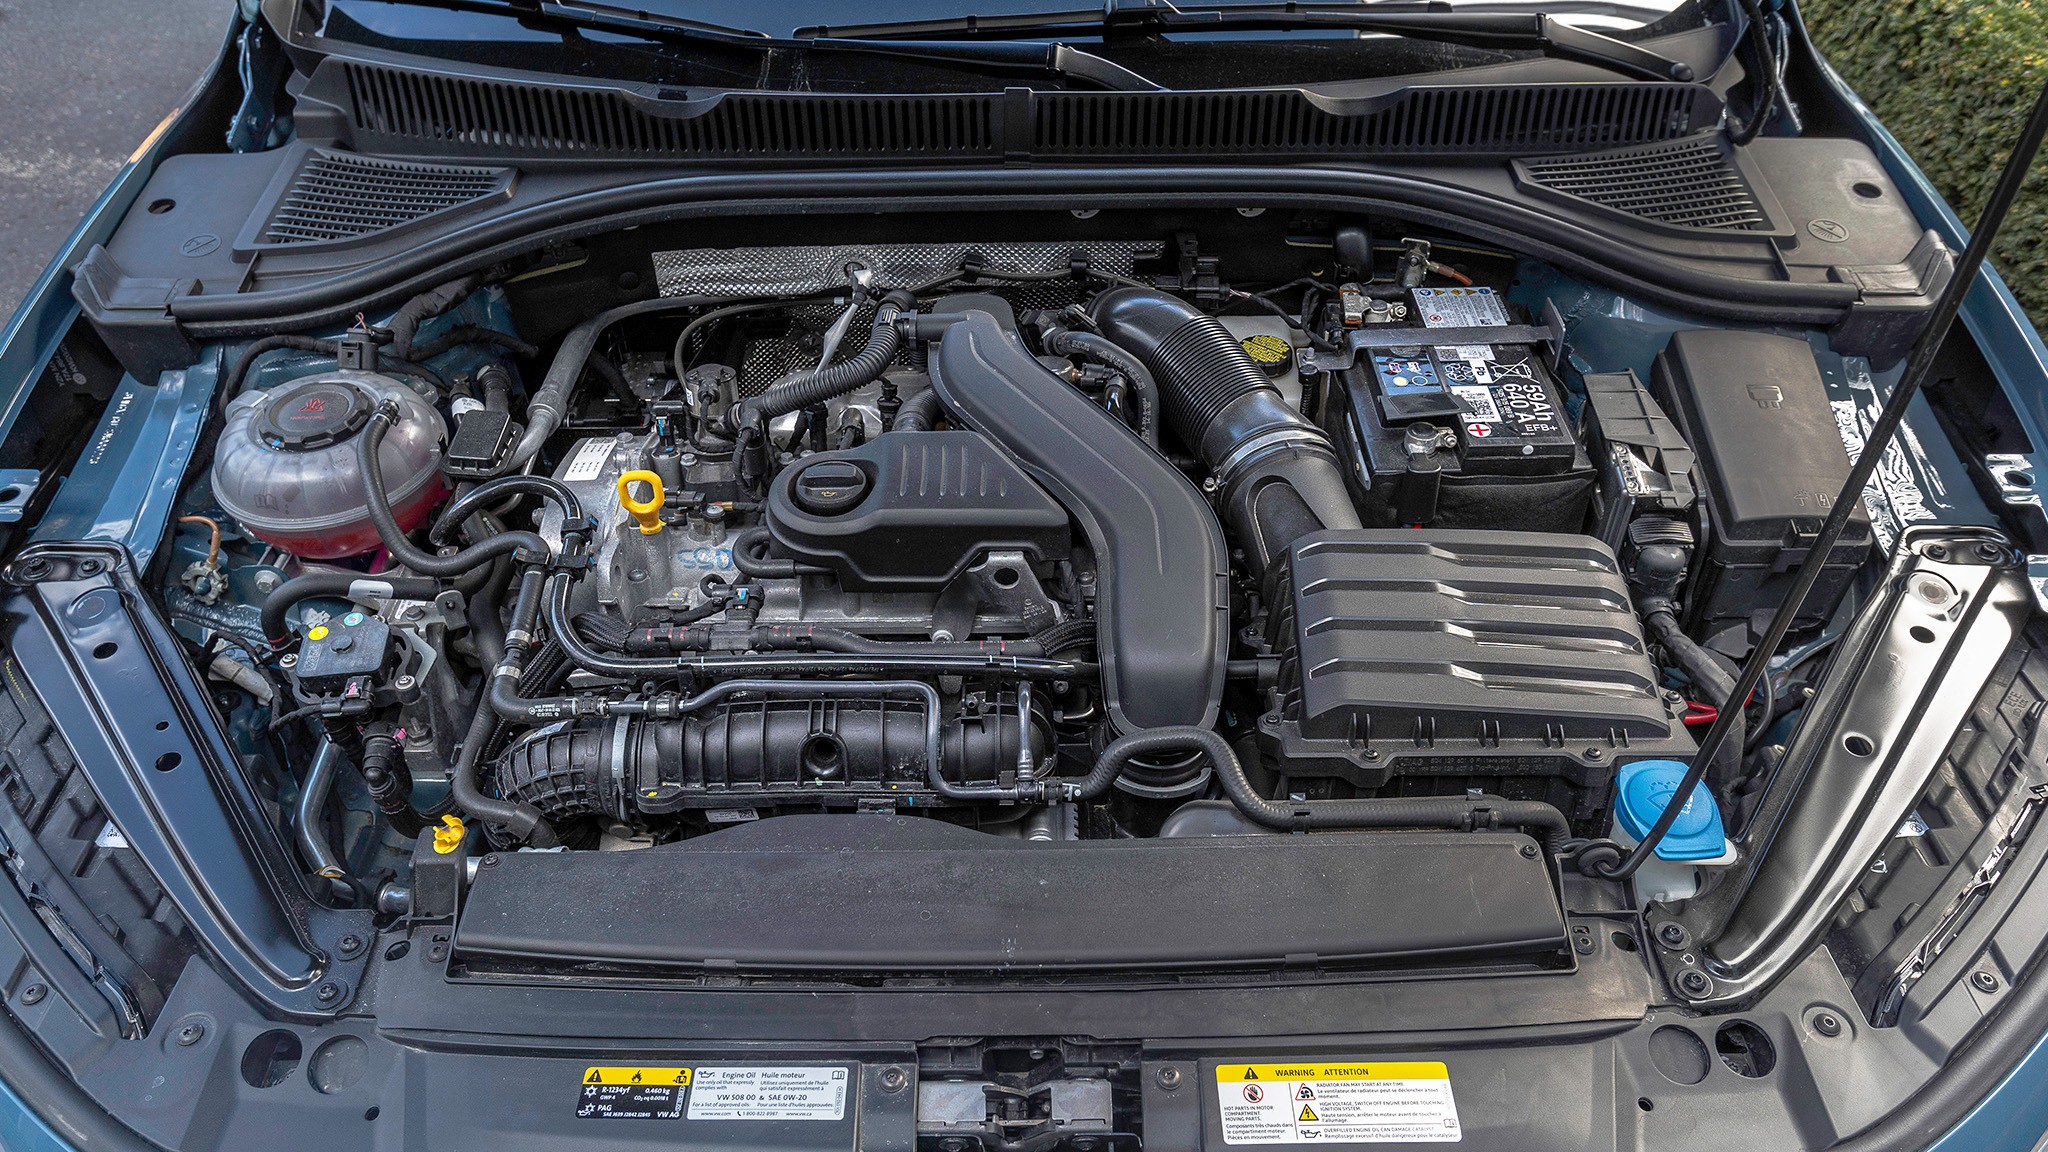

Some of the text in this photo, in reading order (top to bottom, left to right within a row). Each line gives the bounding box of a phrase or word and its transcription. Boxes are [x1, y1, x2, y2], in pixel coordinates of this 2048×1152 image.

[1475, 367, 1485, 376] Pb
[1503, 384, 1530, 409] 640
[1523, 384, 1555, 421] 59Ah
[1514, 411, 1536, 423] A
[1524, 424, 1558, 432] EFB+
[2003, 691, 2023, 707] ECE
[722, 1072, 744, 1080] Engine
[1274, 1068, 1369, 1077] WARNING ATTENTION
[602, 1086, 631, 1094] R-1234yf
